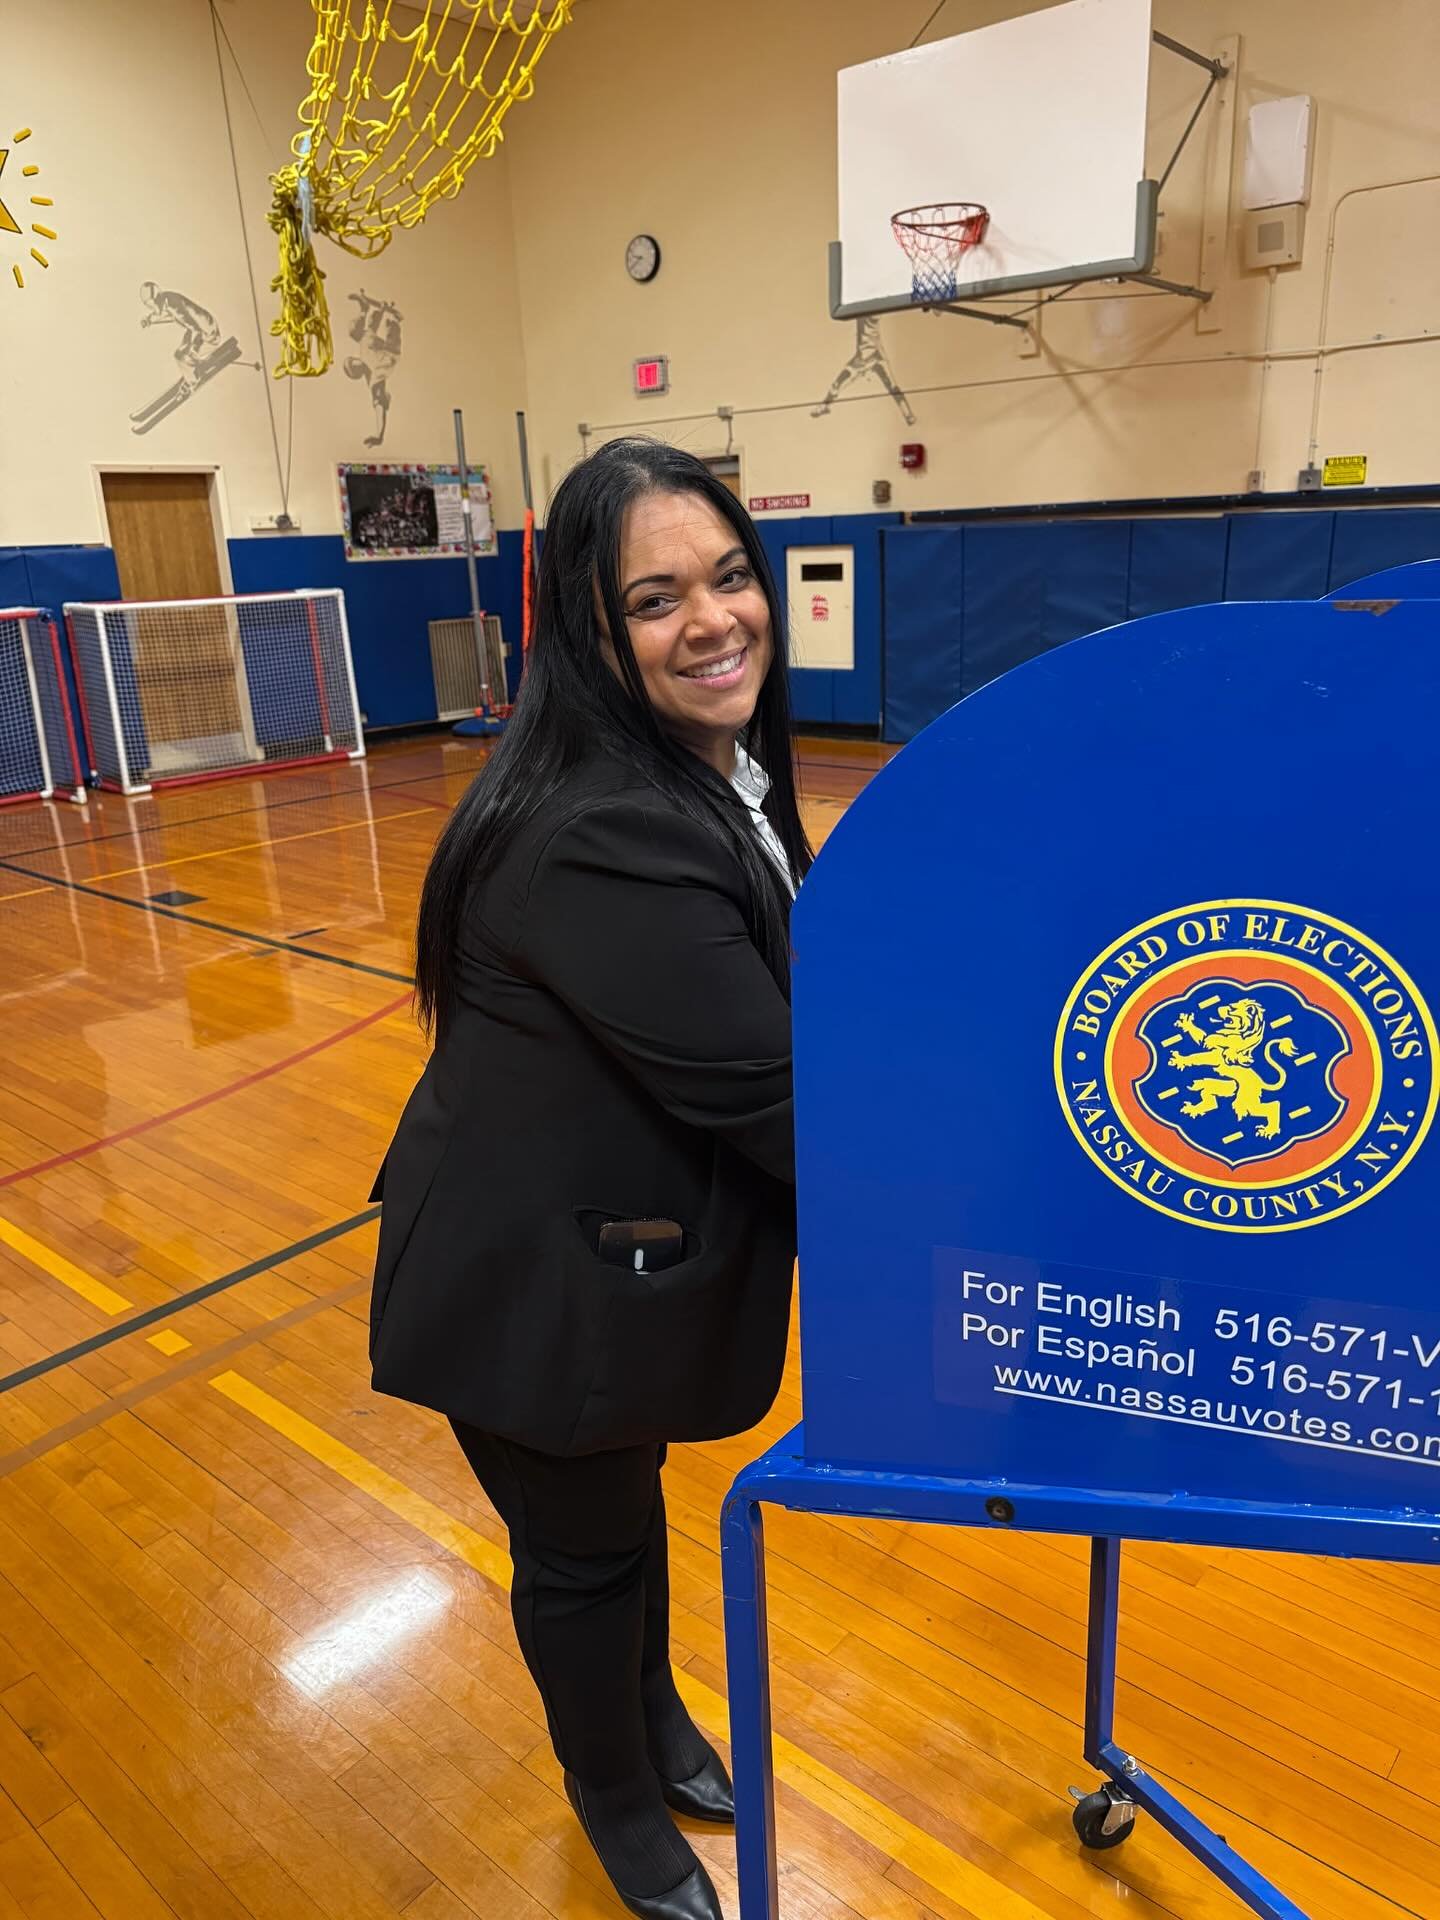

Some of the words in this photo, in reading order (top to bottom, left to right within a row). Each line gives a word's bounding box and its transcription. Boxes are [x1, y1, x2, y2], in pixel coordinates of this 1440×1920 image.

[751, 498, 764, 510] NO
[766, 496, 808, 509] SMOKING
[1072, 936, 1168, 1039] BOARD
[1177, 914, 1230, 946] OF
[1242, 913, 1424, 1061] ELECTIONS
[1071, 1079, 1176, 1195] NASSAU
[1183, 1170, 1364, 1220] COUNTY,
[1355, 1110, 1415, 1174] N.Y.
[962, 1312, 1025, 1348] Por
[1038, 1325, 1195, 1378] Español
[963, 1270, 1025, 1306] For
[1037, 1282, 1181, 1332] English
[1214, 1309, 1440, 1368] 516-571-V
